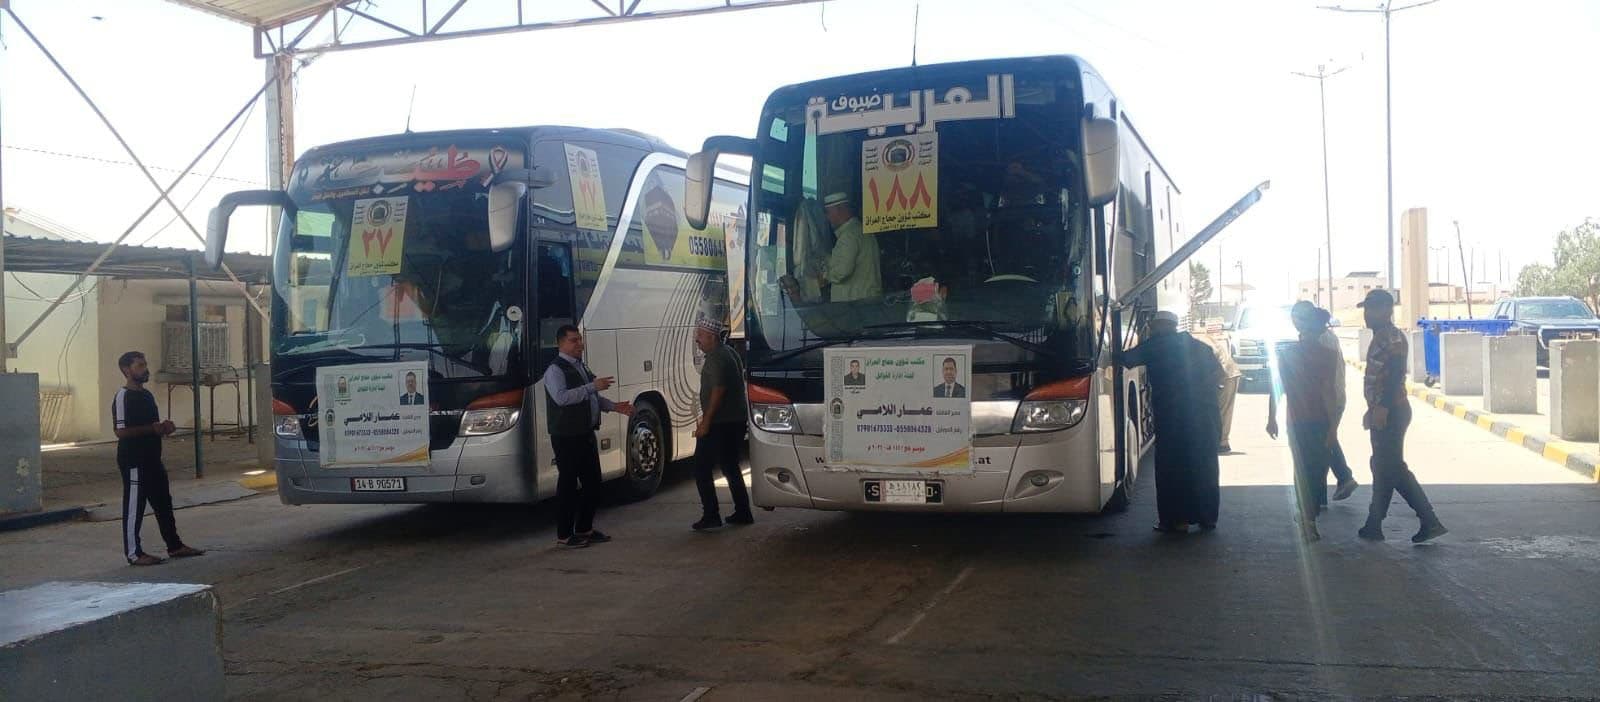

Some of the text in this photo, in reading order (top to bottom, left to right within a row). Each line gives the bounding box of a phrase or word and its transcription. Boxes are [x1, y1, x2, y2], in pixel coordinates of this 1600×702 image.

[805, 74, 1015, 136] ضيوف العربية
[868, 171, 932, 213] ١٨٨
[856, 403, 896, 419] اللامي
[897, 403, 933, 417] عمار
